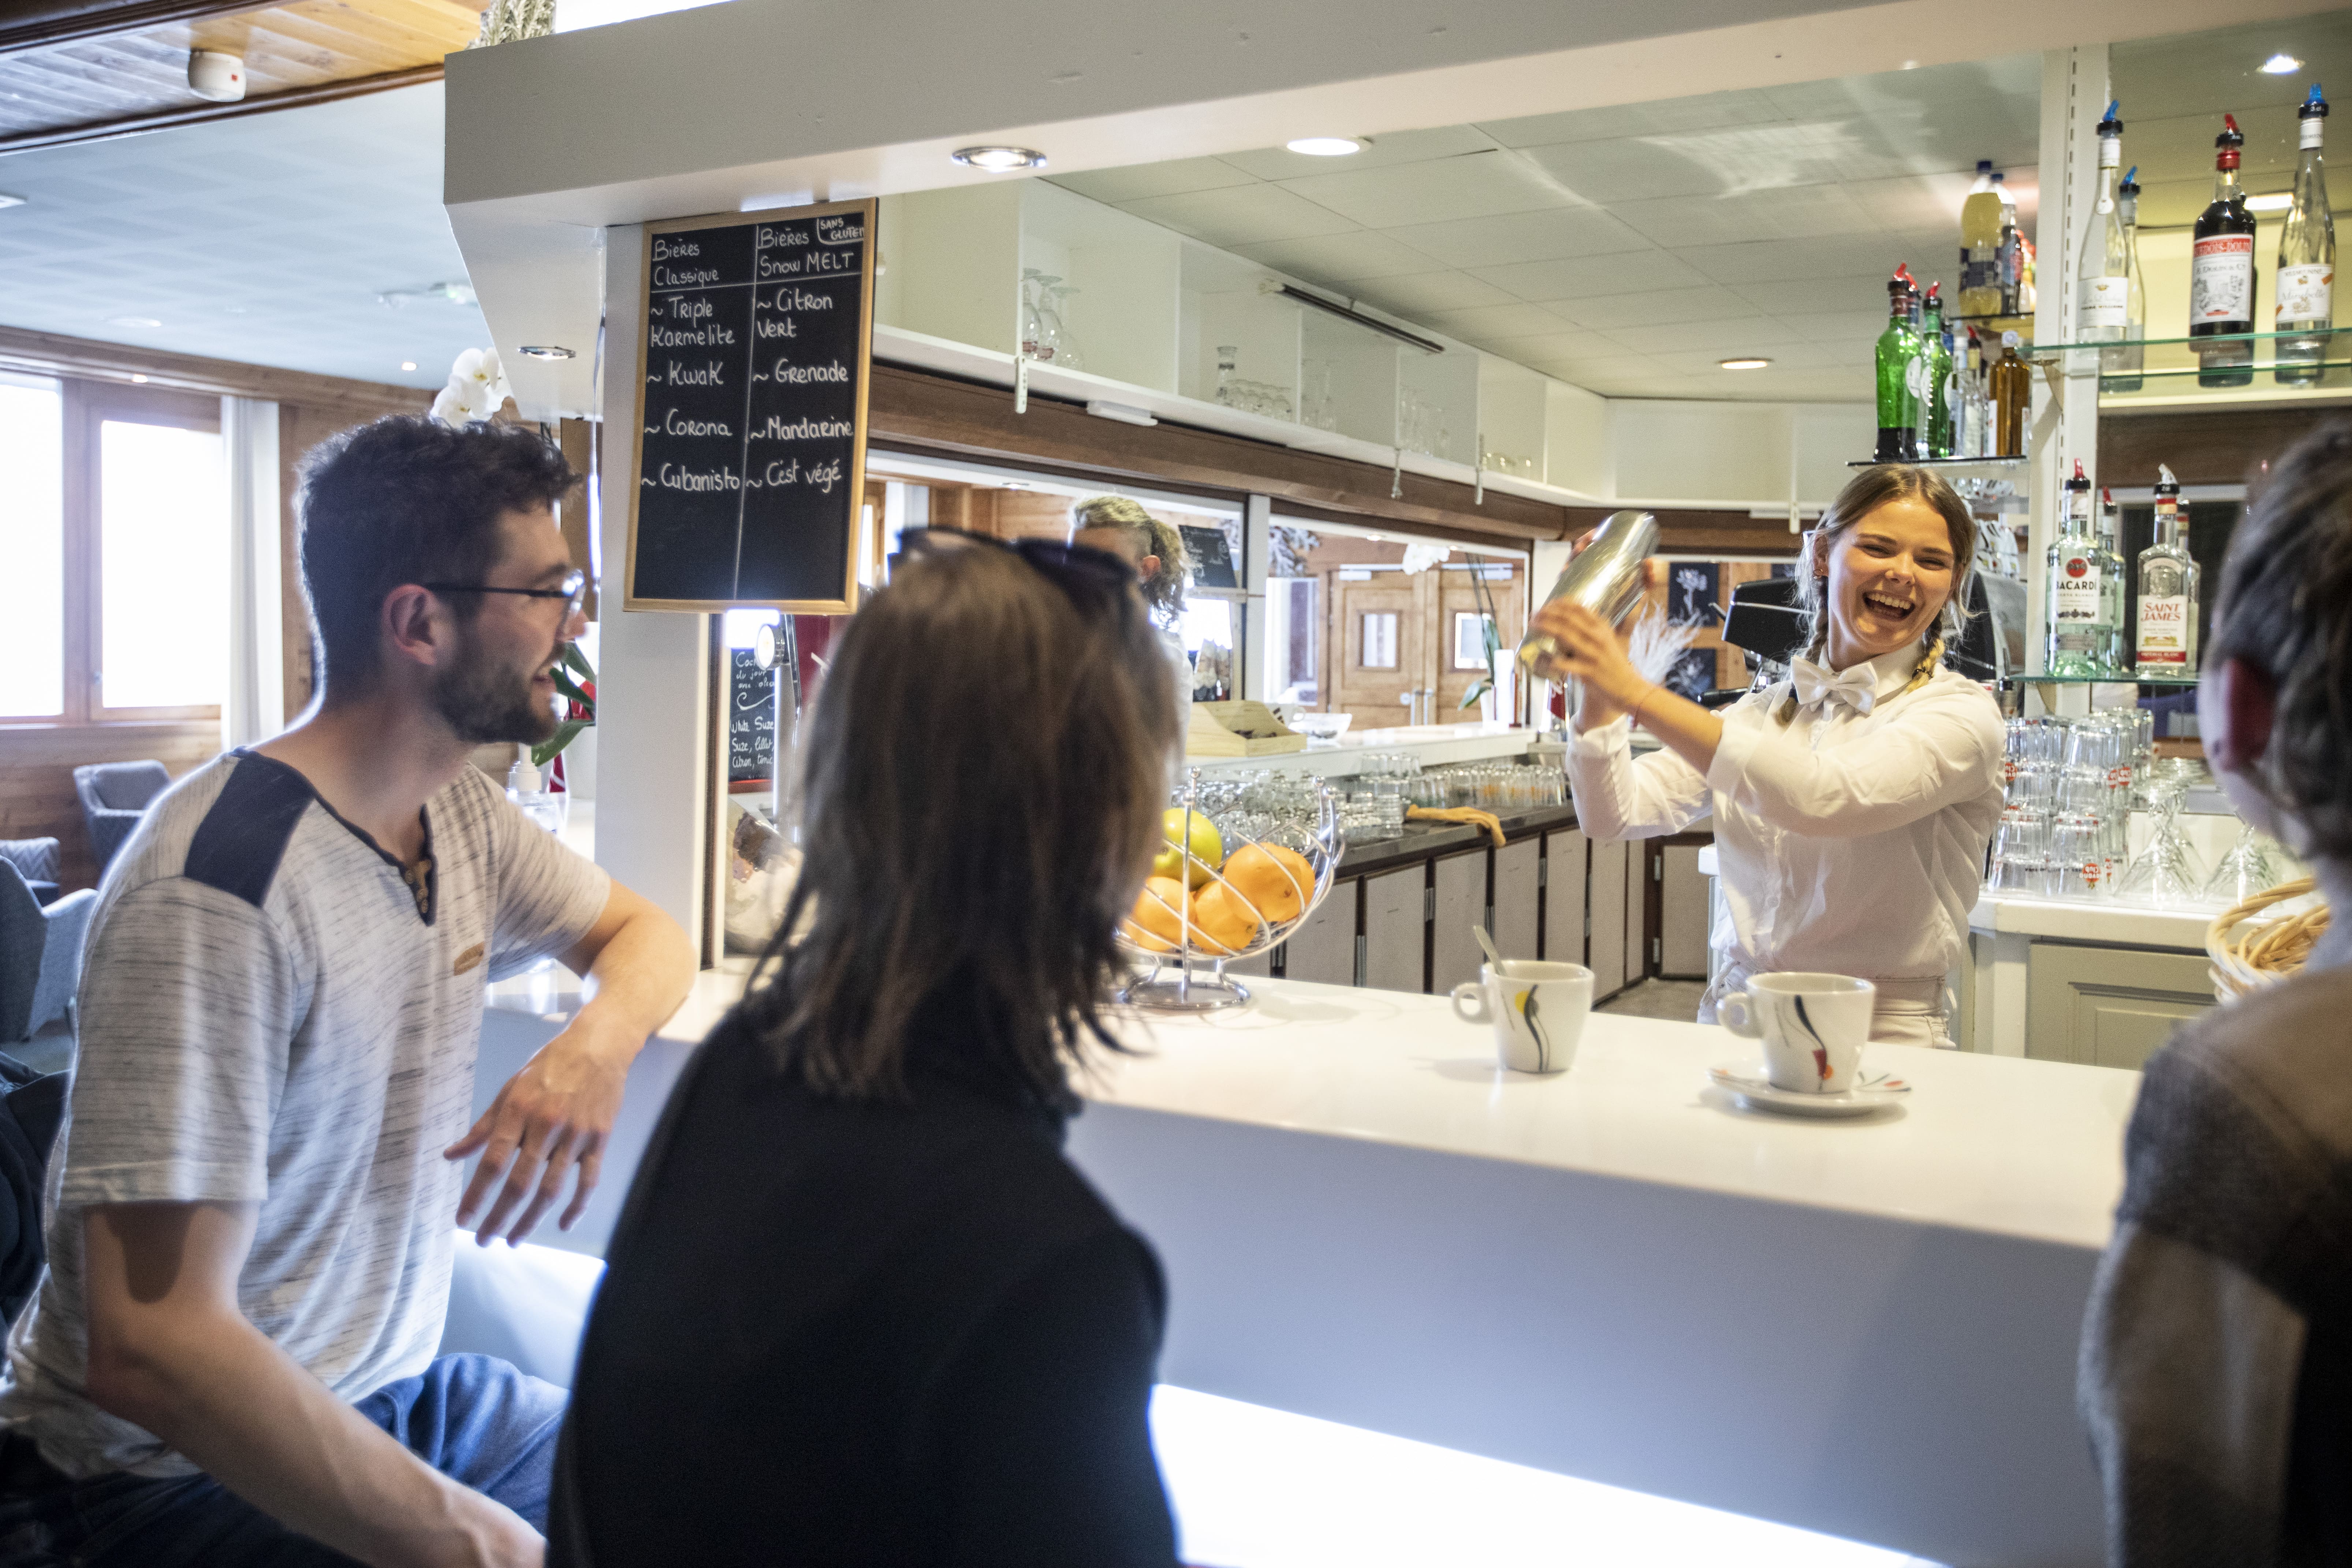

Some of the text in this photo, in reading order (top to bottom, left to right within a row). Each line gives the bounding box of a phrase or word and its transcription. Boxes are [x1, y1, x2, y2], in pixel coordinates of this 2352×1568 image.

[820, 217, 844, 230] SANS
[652, 239, 700, 261] Bières
[758, 228, 809, 249] Bières
[760, 252, 854, 276] Snow MELT
[654, 266, 720, 289] Classique
[668, 295, 713, 327] Triple
[776, 288, 833, 312] Citron
[651, 324, 735, 347] Karmelite
[757, 318, 796, 338] Vert
[775, 358, 849, 384] Grenade
[666, 409, 733, 436] Corona
[768, 416, 854, 440] Mandarine
[660, 463, 739, 491] Cubanisto
[806, 459, 842, 493] végé
[2142, 612, 2181, 622] JAMES
[2145, 602, 2181, 612] SAINT
[736, 670, 746, 680] du
[754, 716, 774, 730] Suze
